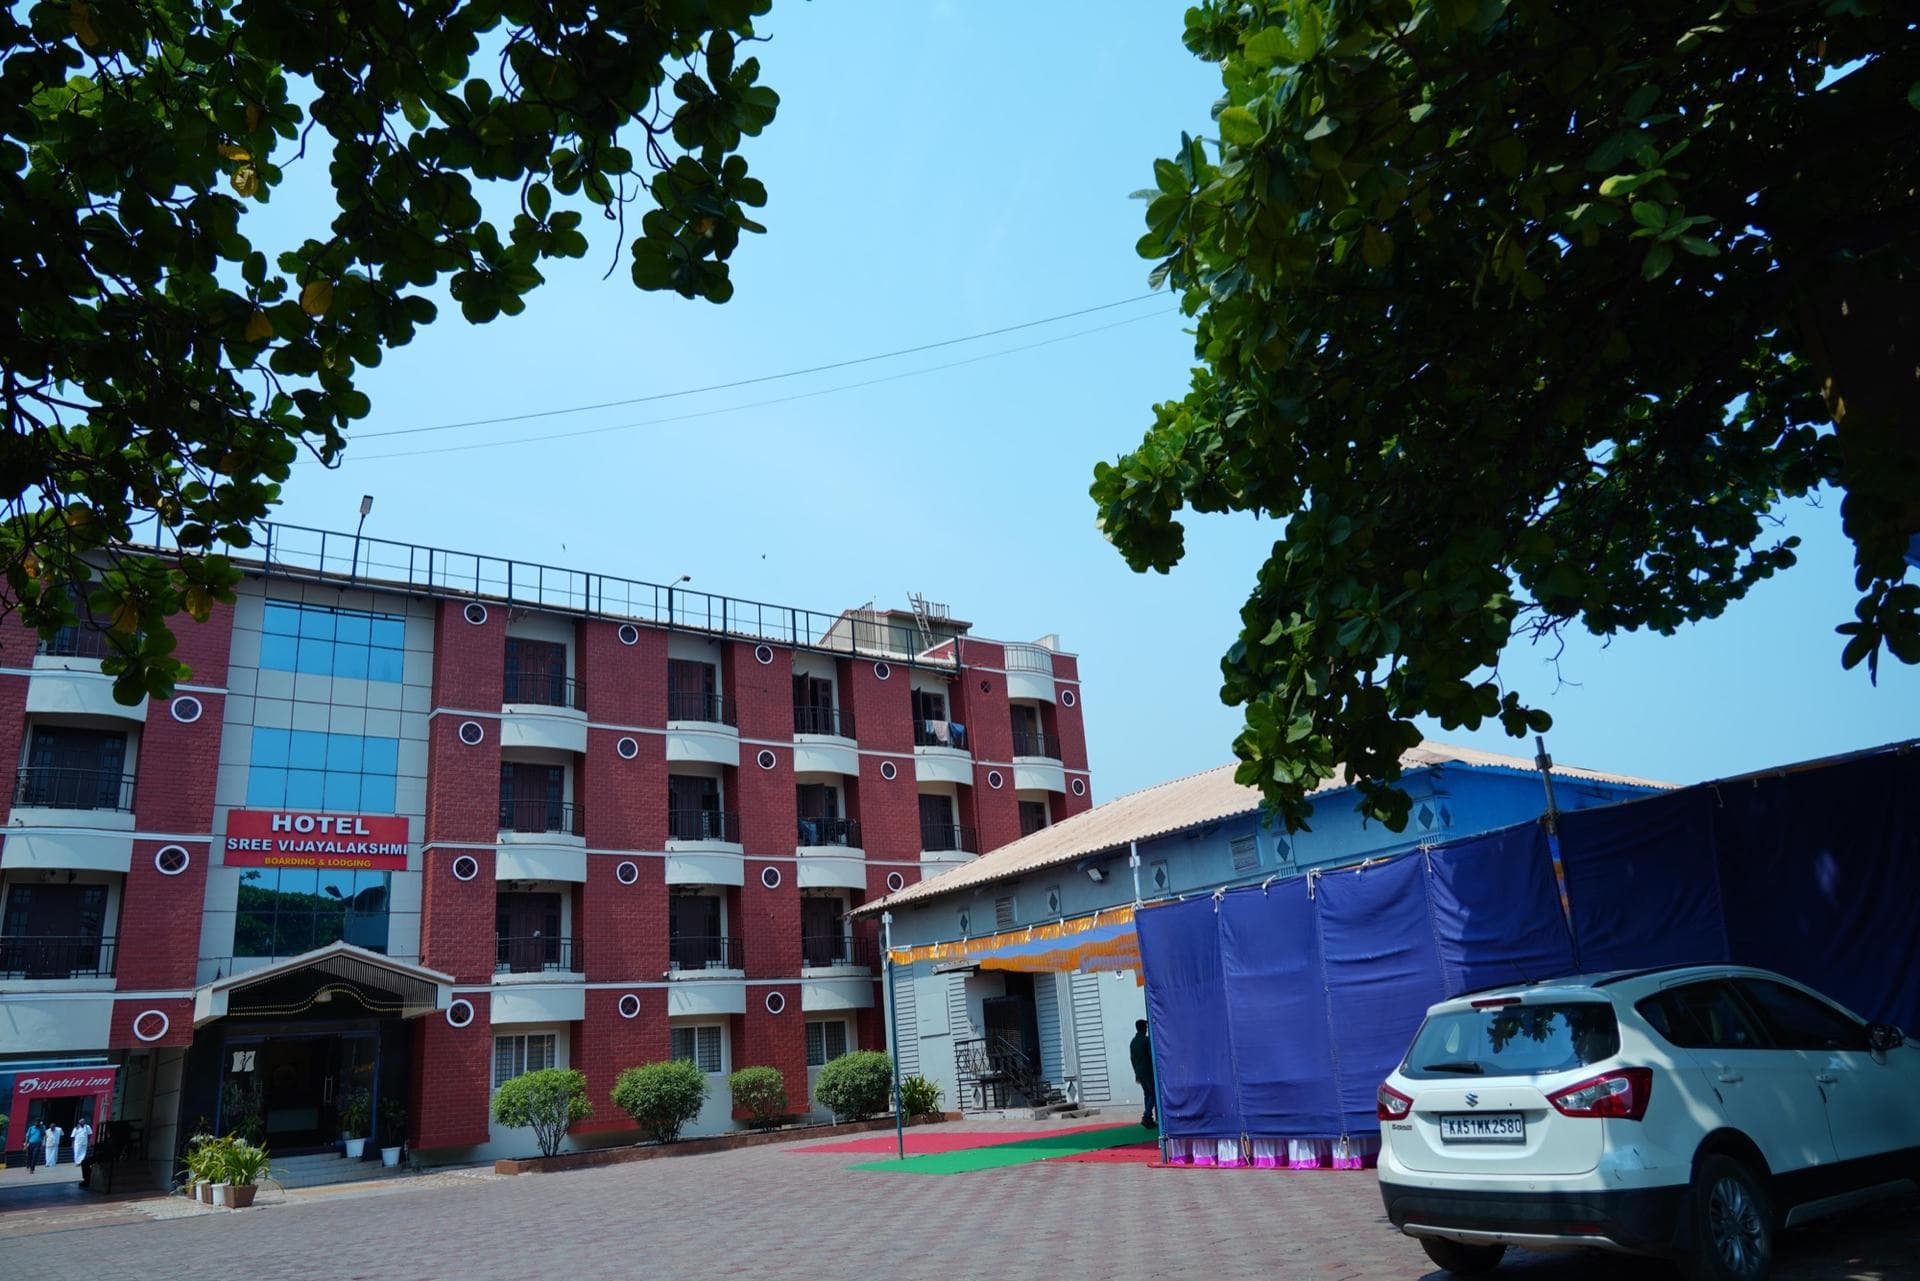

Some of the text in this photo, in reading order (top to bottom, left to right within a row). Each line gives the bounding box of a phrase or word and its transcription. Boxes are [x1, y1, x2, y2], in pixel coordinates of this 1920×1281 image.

[272, 814, 370, 836] HOTEL
[227, 838, 408, 856] SREE VIJAYALAKSHMI
[264, 857, 316, 866] BOARDING
[328, 859, 372, 868] LODGING
[19, 1077, 84, 1093] Dolphin
[1448, 1118, 1522, 1135] KA51MK2580
